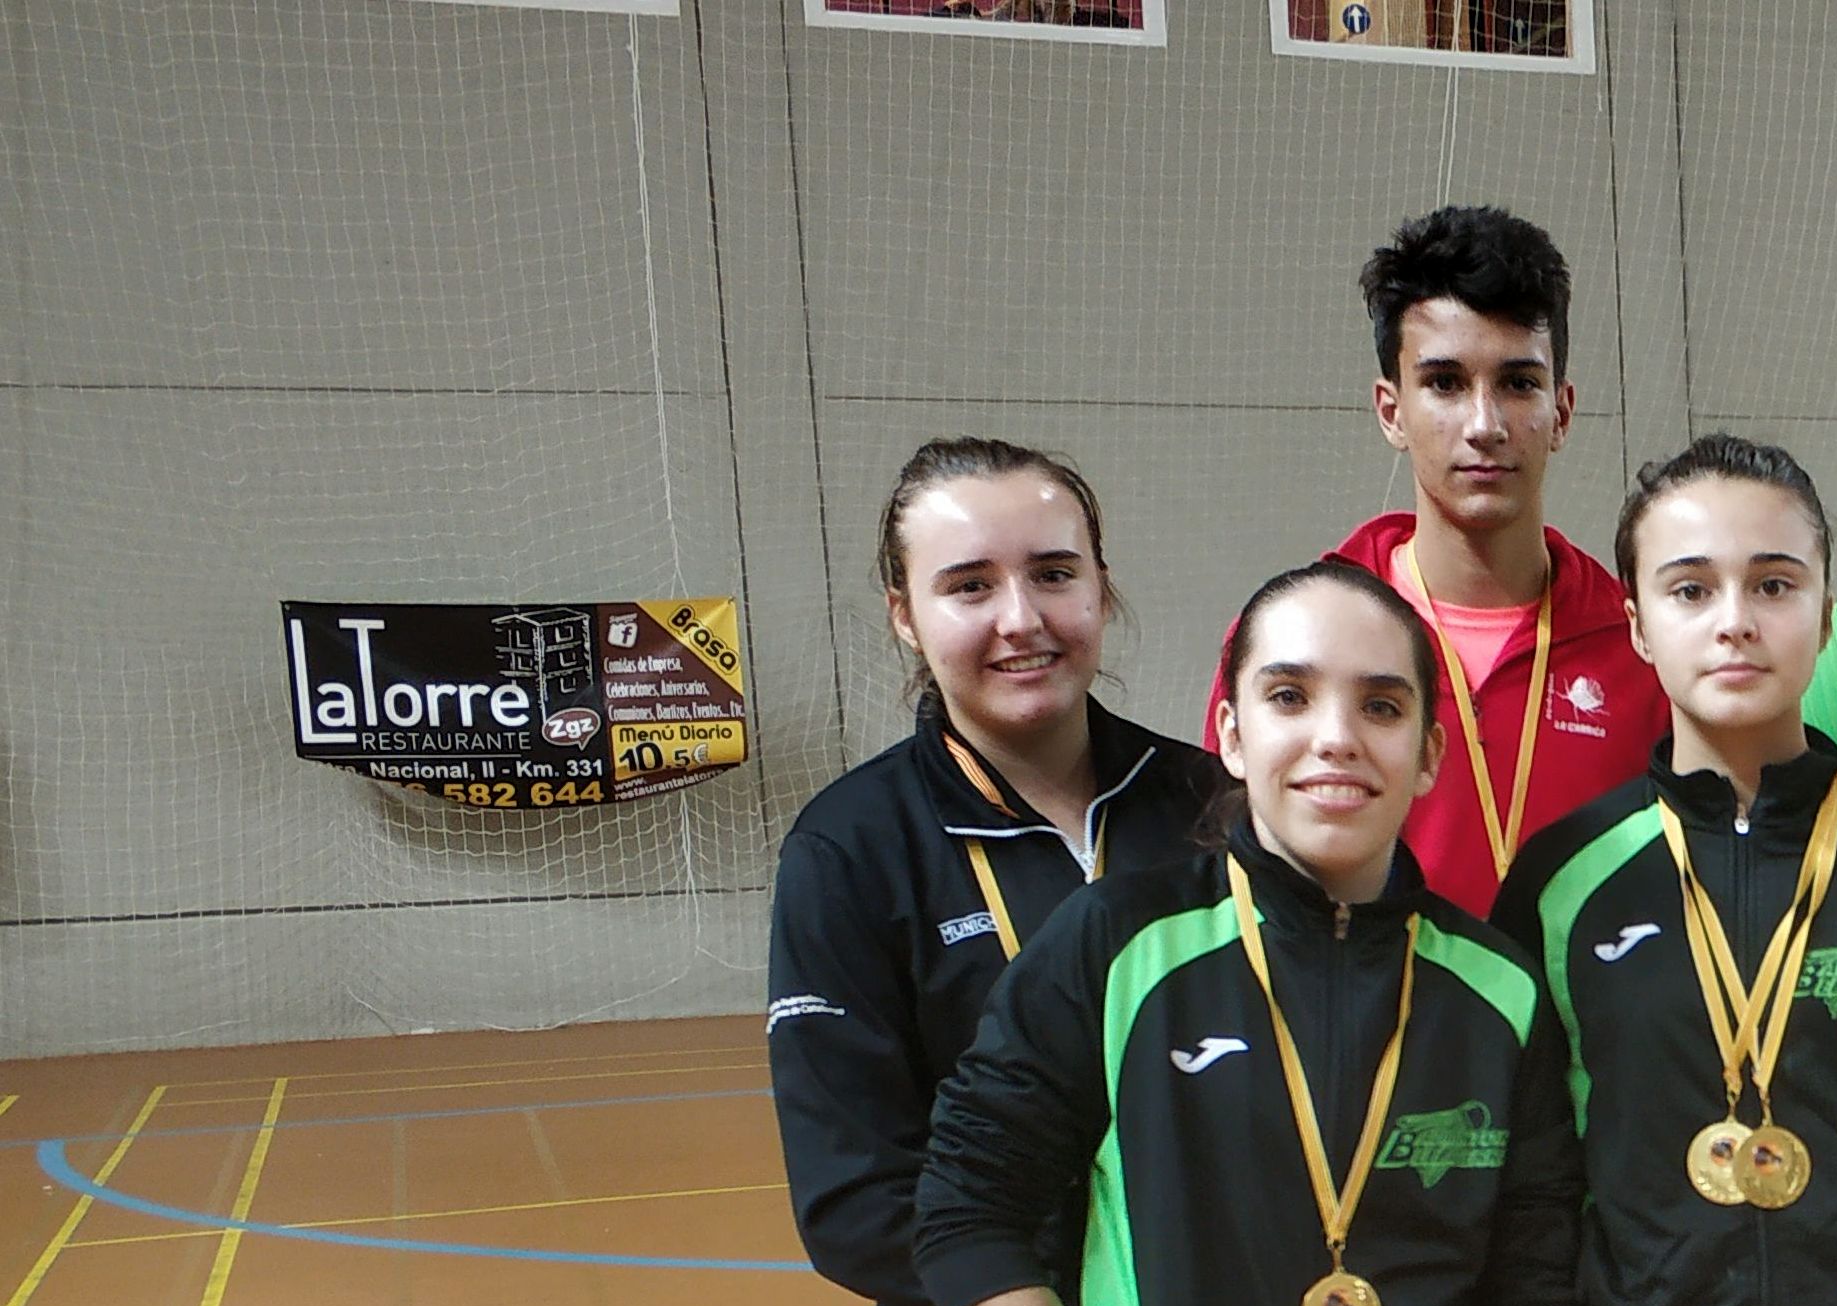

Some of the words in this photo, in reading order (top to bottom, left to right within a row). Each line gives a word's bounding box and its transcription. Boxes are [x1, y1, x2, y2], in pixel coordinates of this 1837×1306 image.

[670, 607, 738, 672] Brasa
[637, 656, 648, 672] de
[647, 655, 684, 674] Empresa,
[660, 679, 711, 697] Aniversarios,
[548, 716, 595, 739] Zgz
[619, 724, 675, 742] Menú
[679, 723, 733, 740] Diario
[361, 731, 532, 751] RESTAURANTE
[369, 761, 475, 781] Nacional,
[516, 760, 560, 778] Km.
[566, 758, 604, 777] 331
[443, 782, 518, 808] 582
[530, 780, 605, 806] 644
